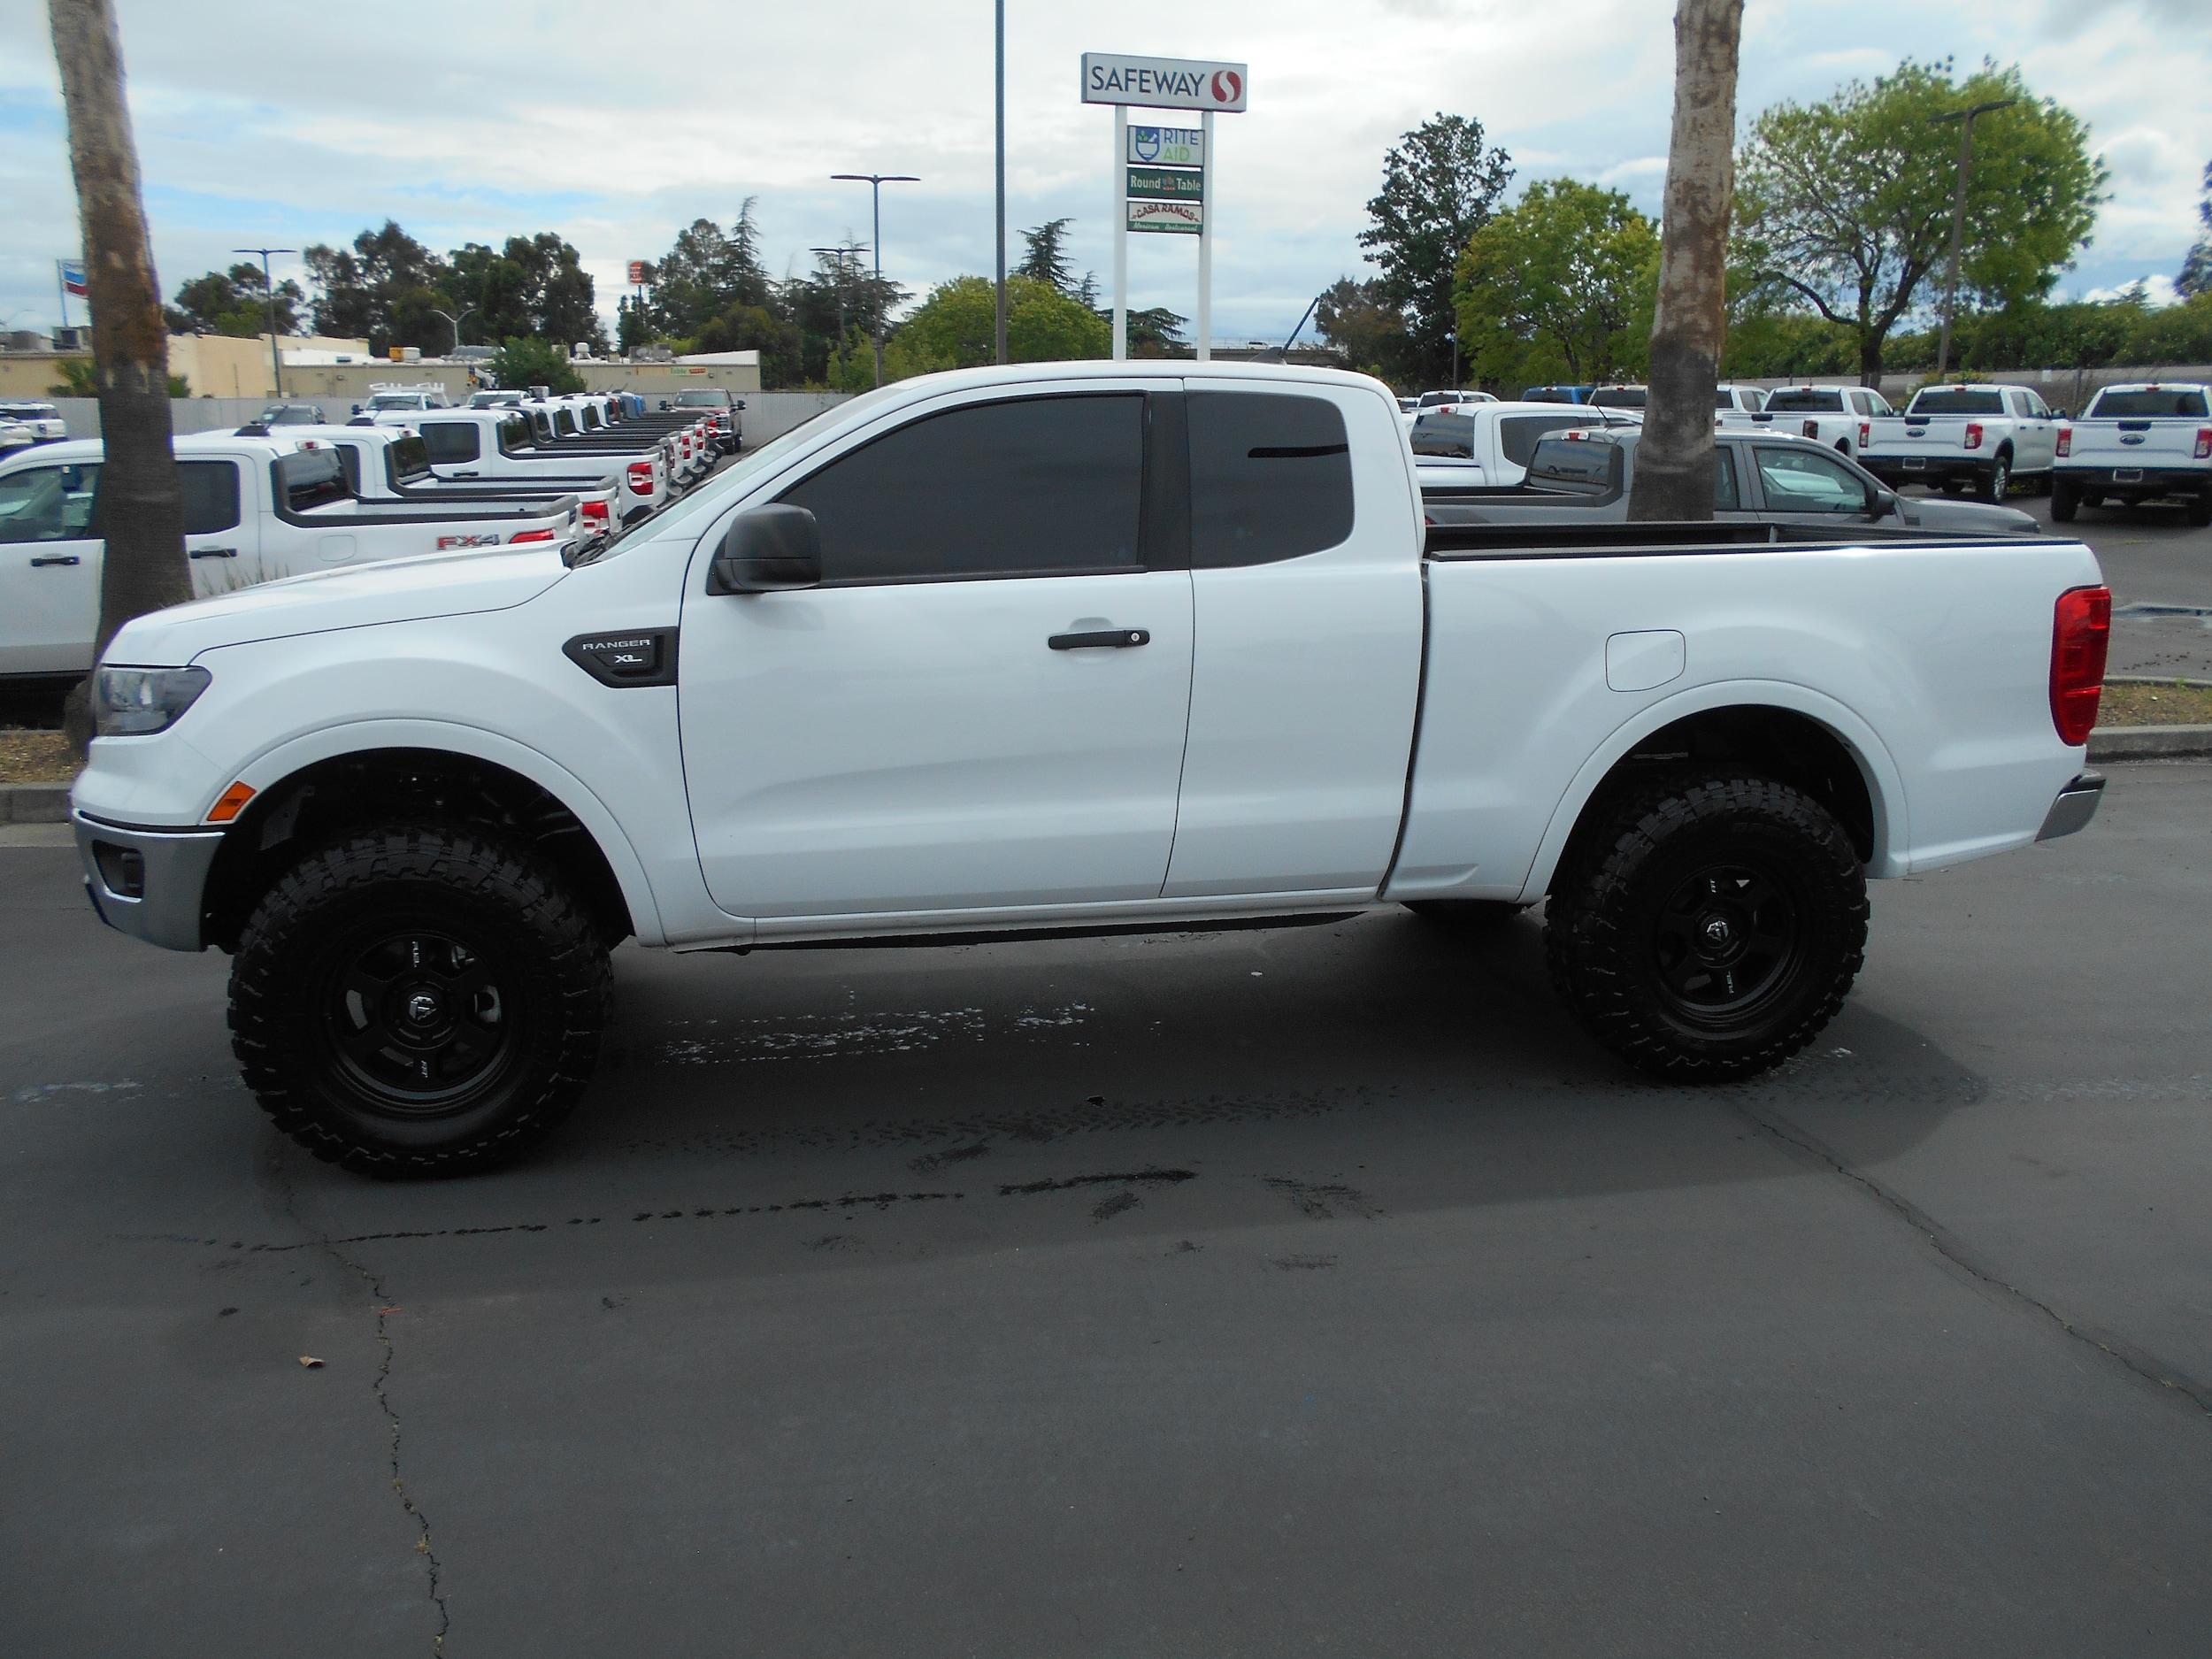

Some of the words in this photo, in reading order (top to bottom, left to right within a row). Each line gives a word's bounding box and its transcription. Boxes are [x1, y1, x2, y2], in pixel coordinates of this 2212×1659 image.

[1091, 65, 1205, 96] SAFEWAY
[1164, 129, 1199, 145] RITE
[1164, 147, 1190, 162] AID
[1130, 175, 1161, 189] Round
[1176, 178, 1202, 191] Table
[1137, 204, 1160, 219] CASA
[1161, 204, 1195, 220] RAMOS
[437, 534, 500, 550] FX4
[582, 639, 650, 650] RANGER
[614, 654, 643, 664] XL
